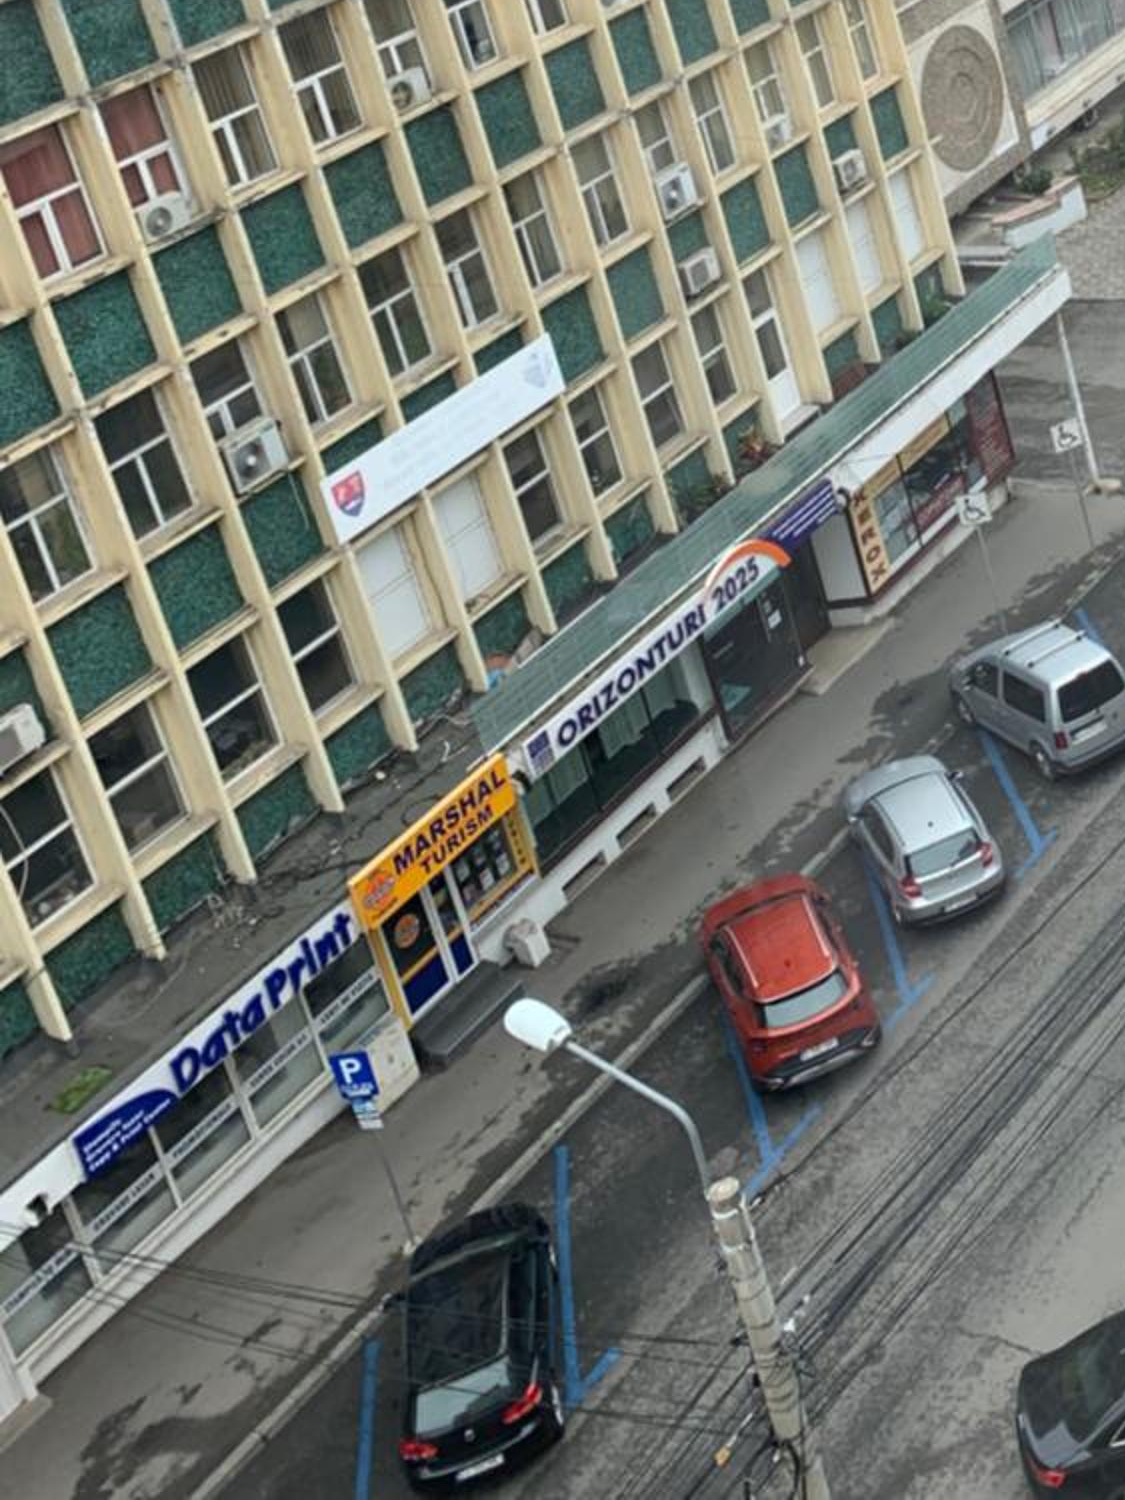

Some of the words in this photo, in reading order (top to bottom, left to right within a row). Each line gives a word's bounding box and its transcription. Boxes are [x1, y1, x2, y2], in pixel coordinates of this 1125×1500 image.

[853, 492, 888, 585] XEROX
[557, 604, 707, 748] ORIZONTURI
[712, 556, 761, 611] 2025
[392, 769, 506, 876] MARSHAL
[419, 804, 494, 875] TURISM
[338, 1057, 362, 1085] P
